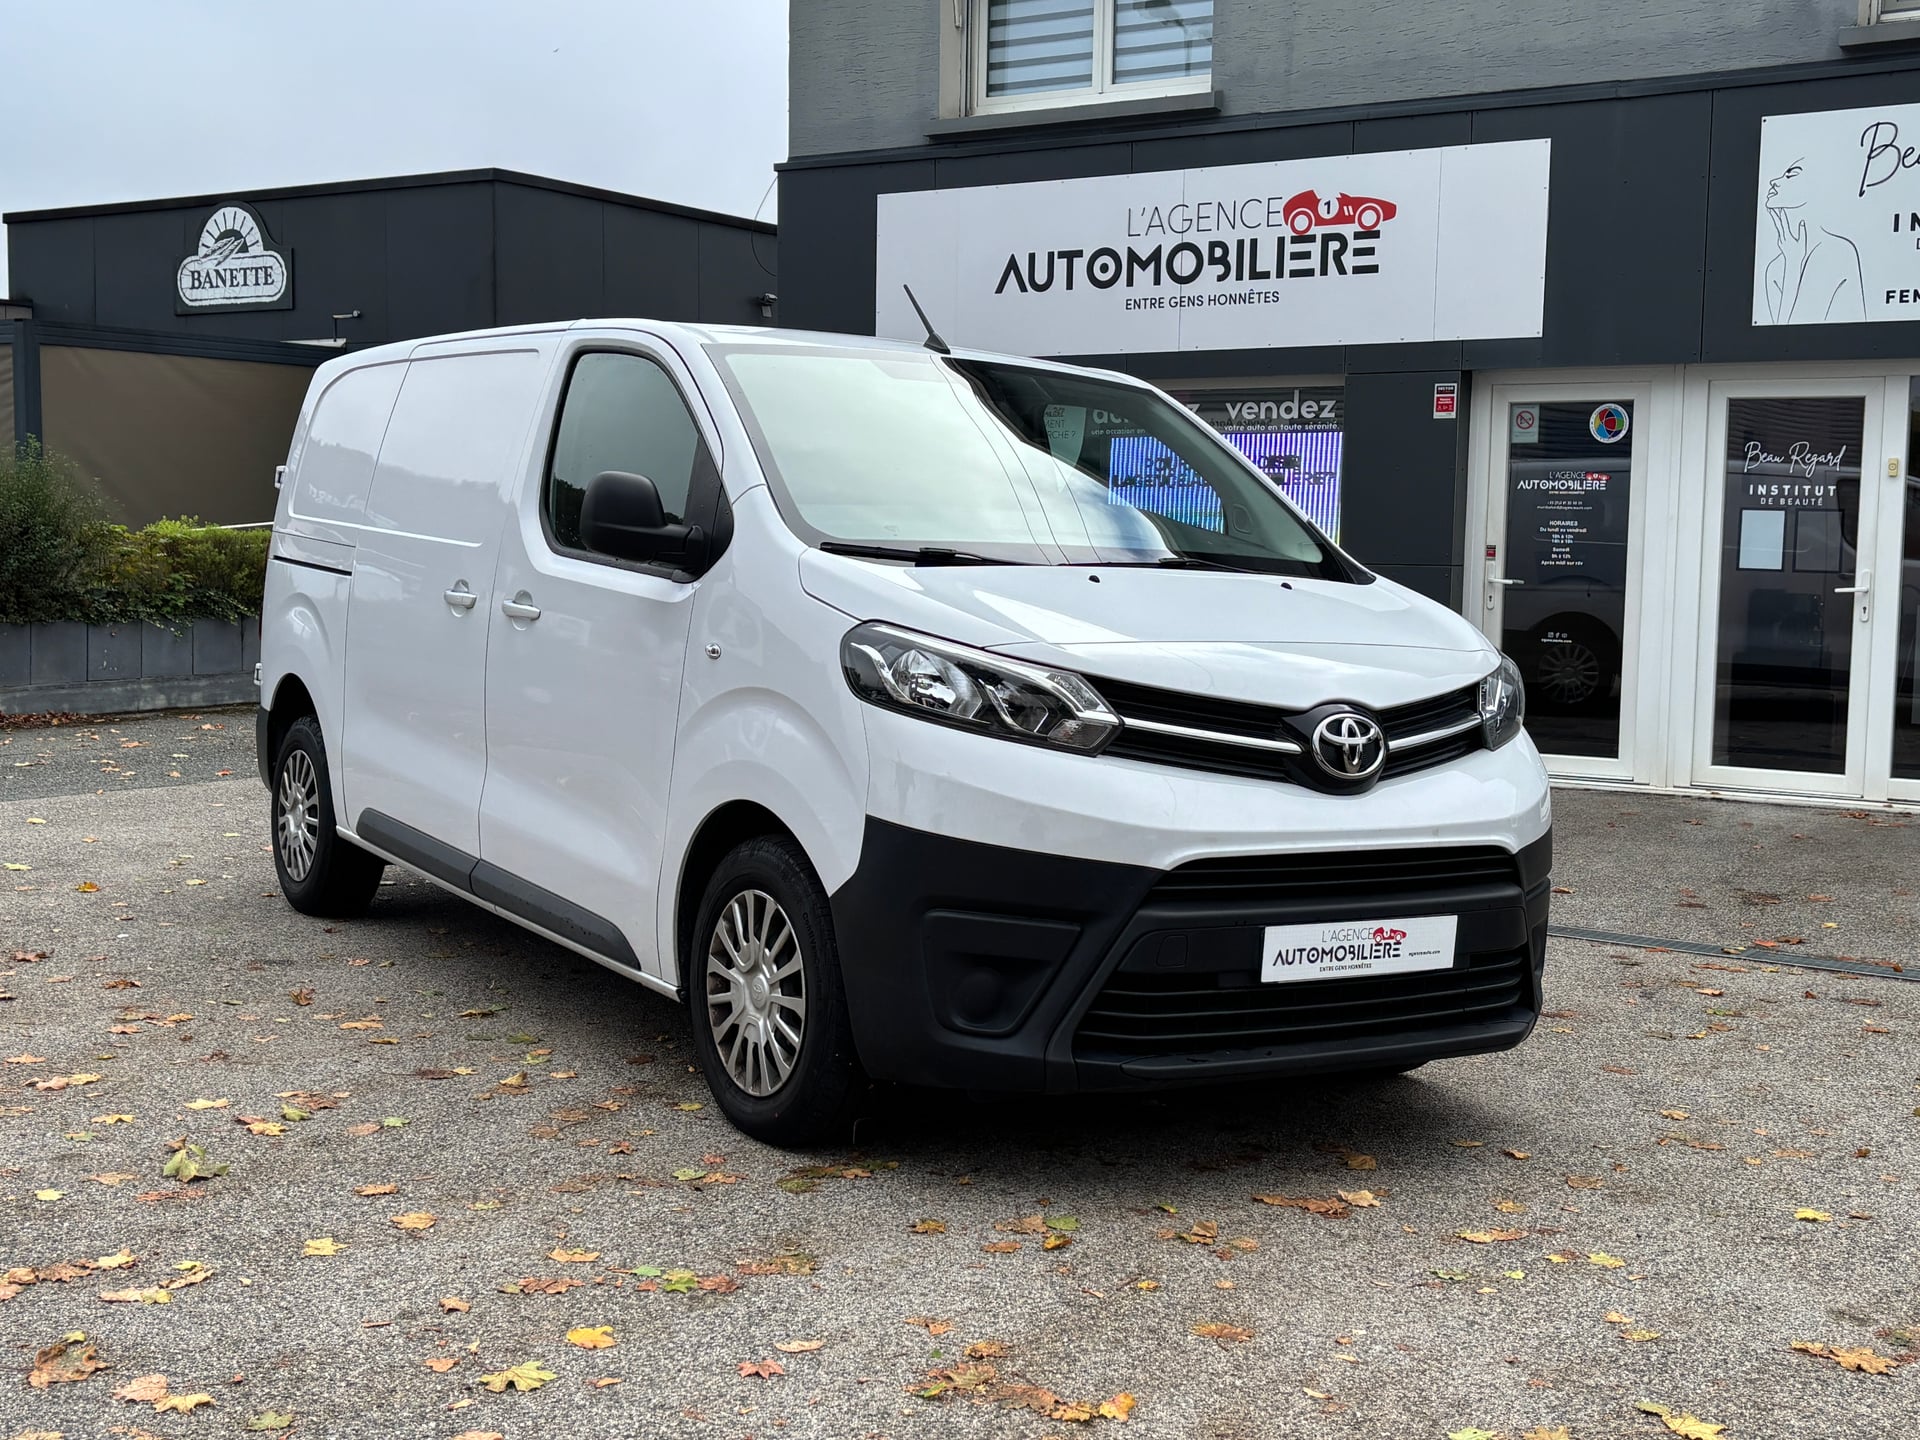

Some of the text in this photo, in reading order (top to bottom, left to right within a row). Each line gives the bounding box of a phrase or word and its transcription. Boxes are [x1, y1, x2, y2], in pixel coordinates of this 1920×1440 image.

[1858, 121, 1920, 197] Be
[1127, 196, 1284, 238] L'AGENCE
[189, 265, 275, 290] BANETTE
[1125, 288, 1280, 311] ENTRE GENS HONNÊTES
[1225, 389, 1337, 420] vendez
[1223, 424, 1245, 432] votre
[1280, 423, 1302, 431] toute
[1743, 441, 1847, 478] Beau Regard
[1549, 471, 1586, 479] L'AGENCE
[1749, 484, 1838, 497] INSTITUT
[1760, 496, 1824, 506] DE BEAUTÉ
[1321, 927, 1374, 943] L'AGENCE
